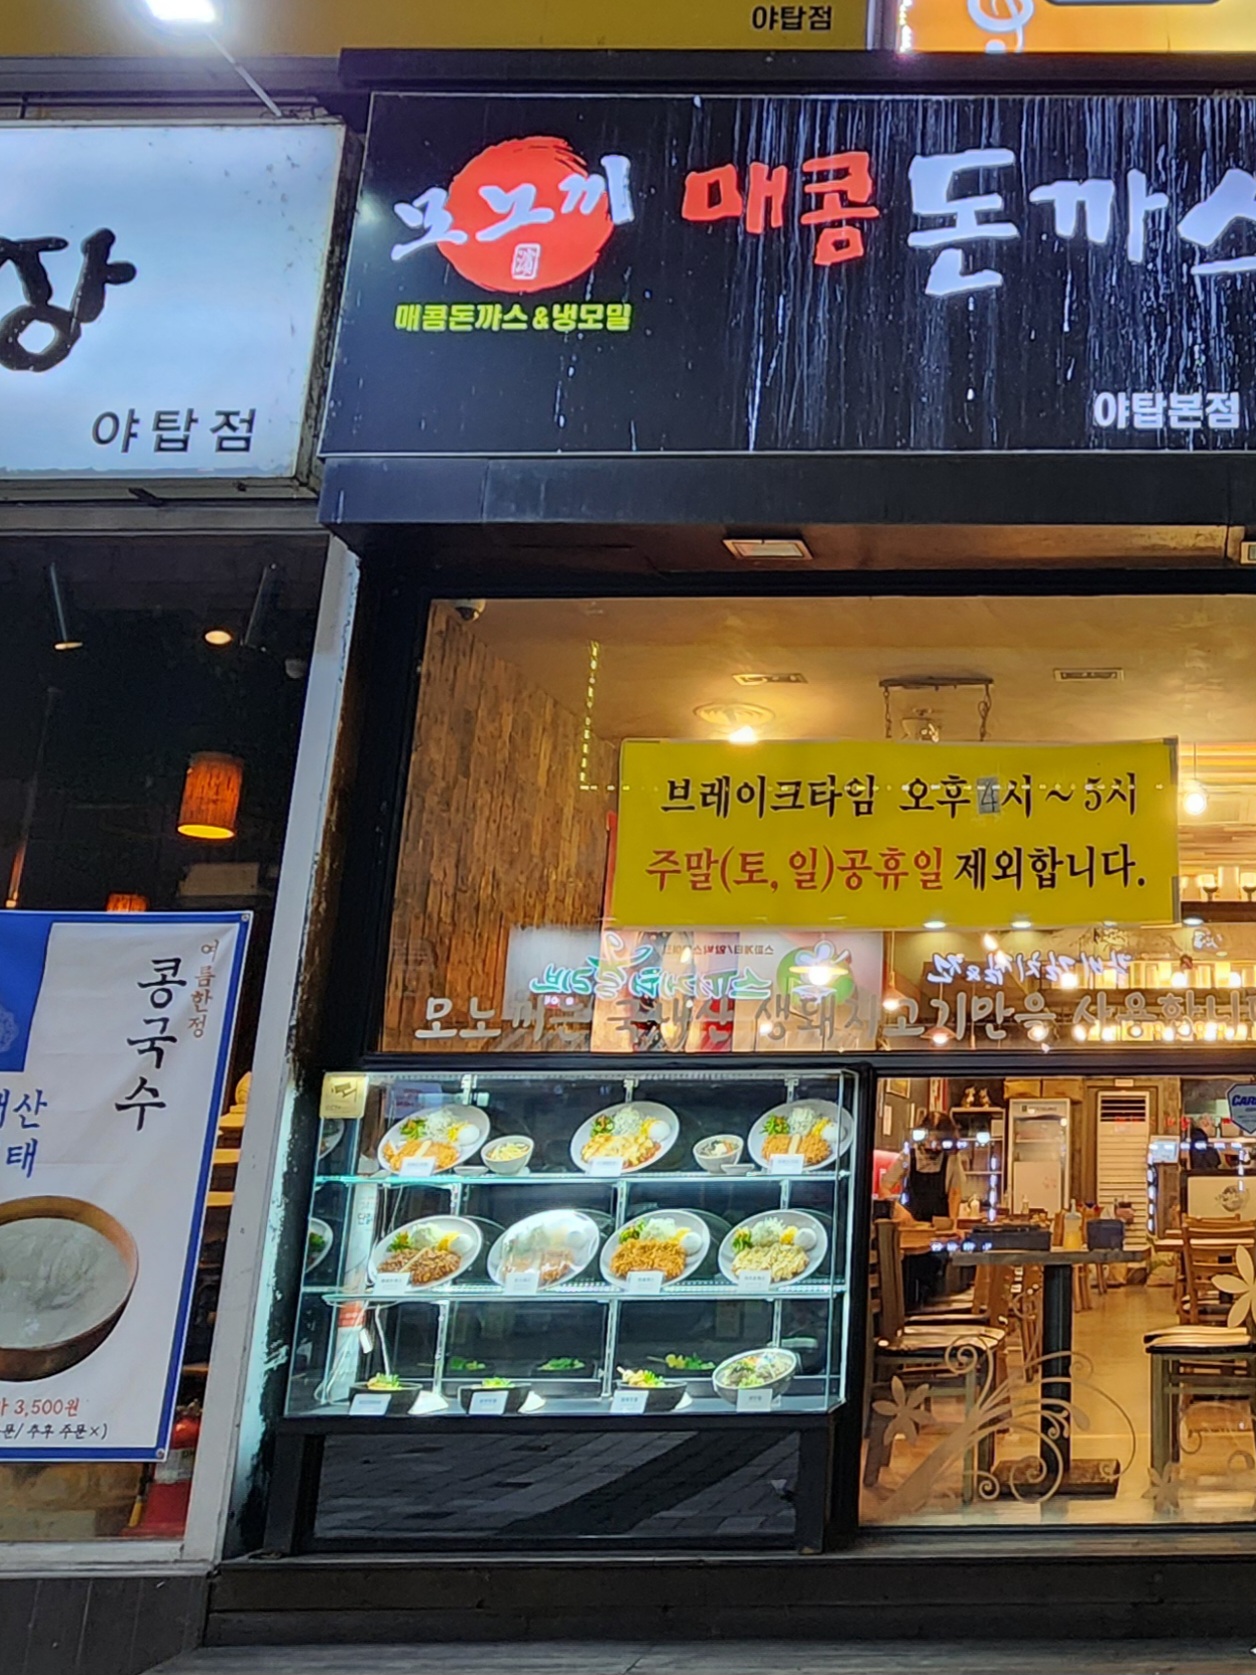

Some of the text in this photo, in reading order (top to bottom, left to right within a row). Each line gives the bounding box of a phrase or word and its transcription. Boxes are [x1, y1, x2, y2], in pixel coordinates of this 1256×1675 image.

[752, 5, 832, 30] 야탑점
[91, 407, 256, 453] 야탑점
[1093, 391, 1240, 429] 야탑본점
[661, 774, 876, 819] 브레이크타임
[954, 843, 1147, 891] 제외합니다.
[188, 939, 220, 1038] 여름한정
[114, 957, 187, 1131] 콩국수
[14, 1397, 80, 1417] 3,500원
